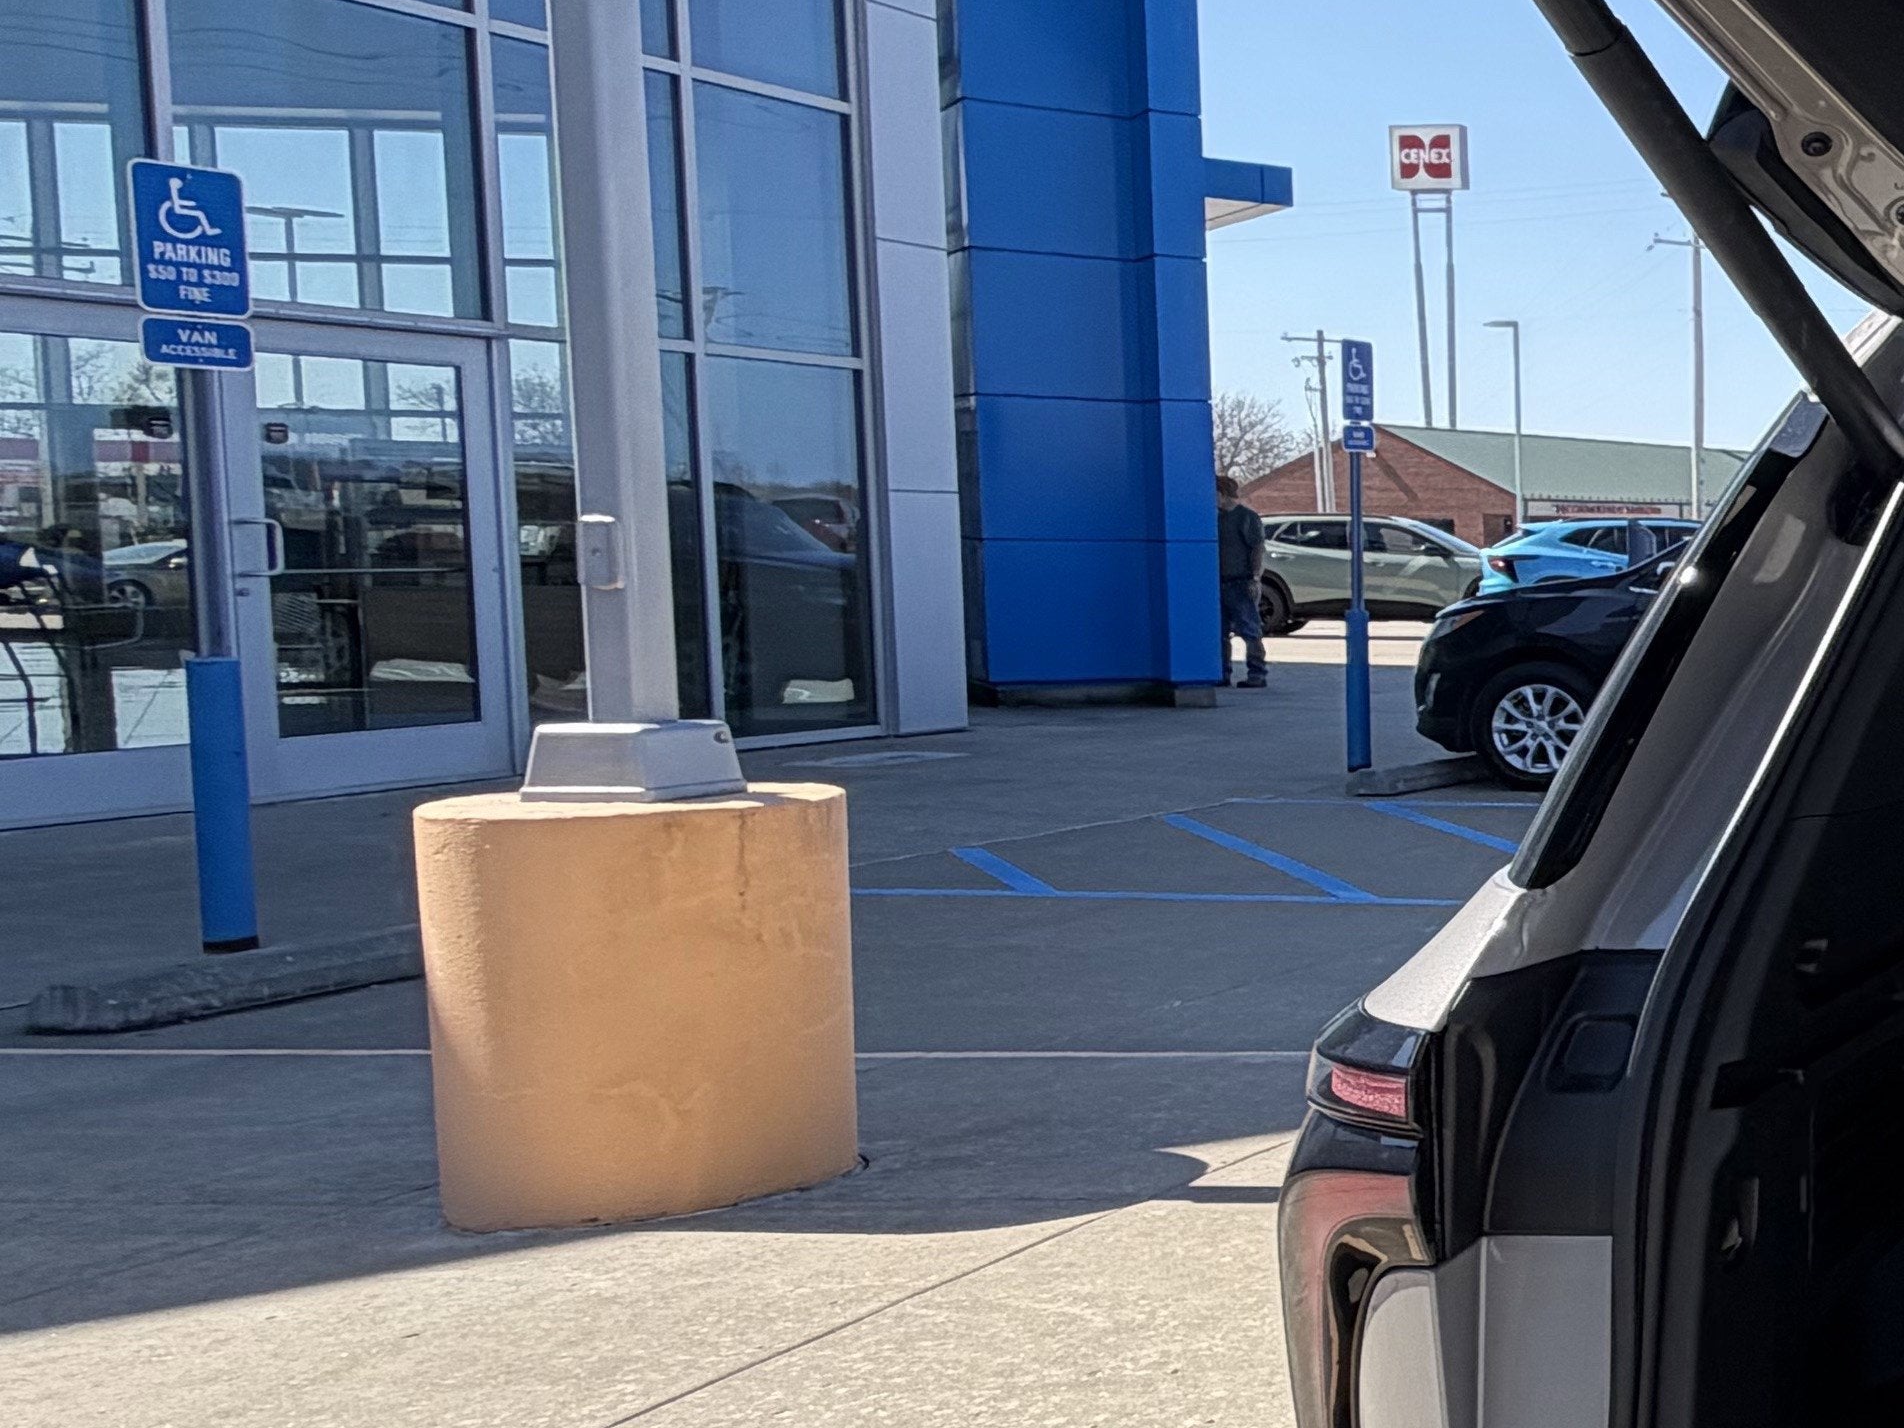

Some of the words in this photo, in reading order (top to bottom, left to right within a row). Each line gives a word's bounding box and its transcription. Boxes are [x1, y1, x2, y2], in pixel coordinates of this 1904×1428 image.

[1400, 147, 1452, 166] CENEX
[152, 240, 232, 268] PARKING
[146, 263, 177, 281] $50
[179, 266, 199, 283] TO
[178, 284, 213, 303] FINE
[176, 328, 218, 346] VAN
[160, 344, 238, 361] ACCESSIBLE
